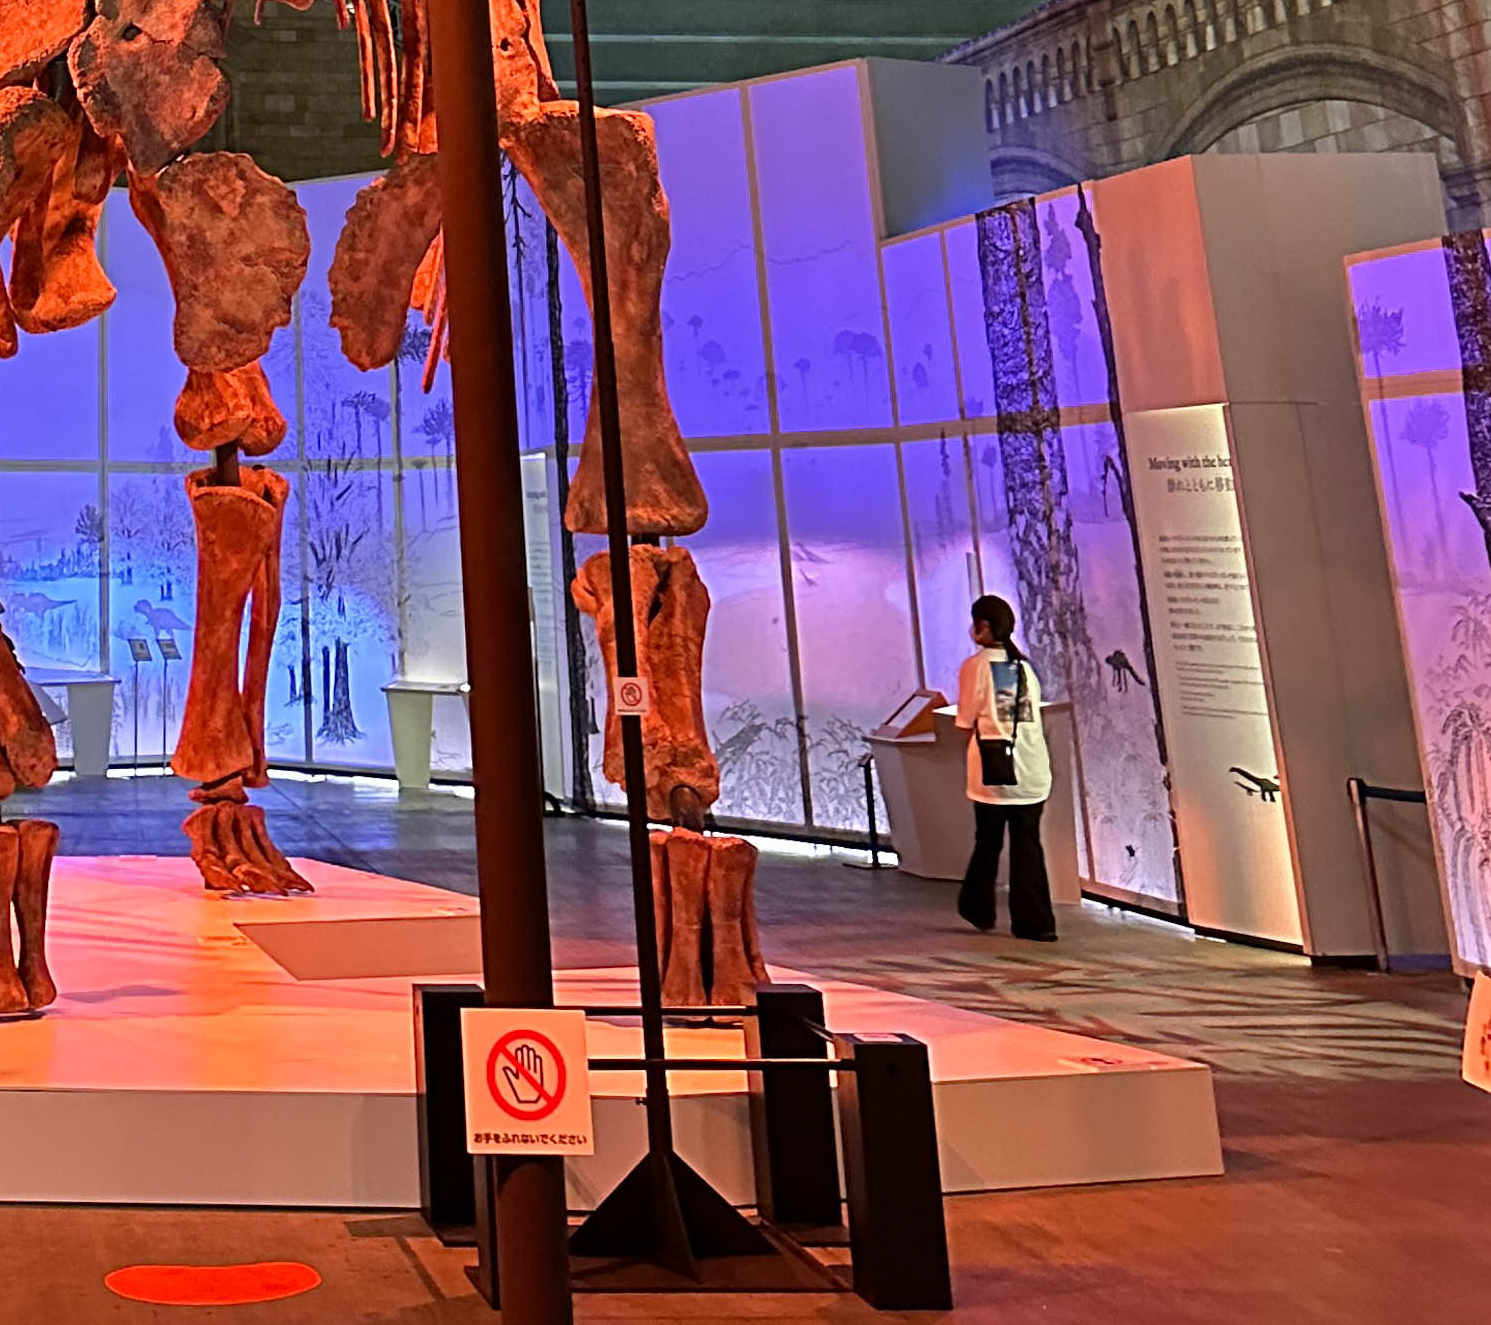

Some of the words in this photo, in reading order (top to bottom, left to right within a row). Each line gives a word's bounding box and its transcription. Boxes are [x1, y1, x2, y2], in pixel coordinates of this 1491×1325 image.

[1149, 457, 1181, 472] Moving
[1182, 455, 1200, 469] with
[1202, 455, 1216, 468] the
[474, 1133, 588, 1145] お手をふれないでください
